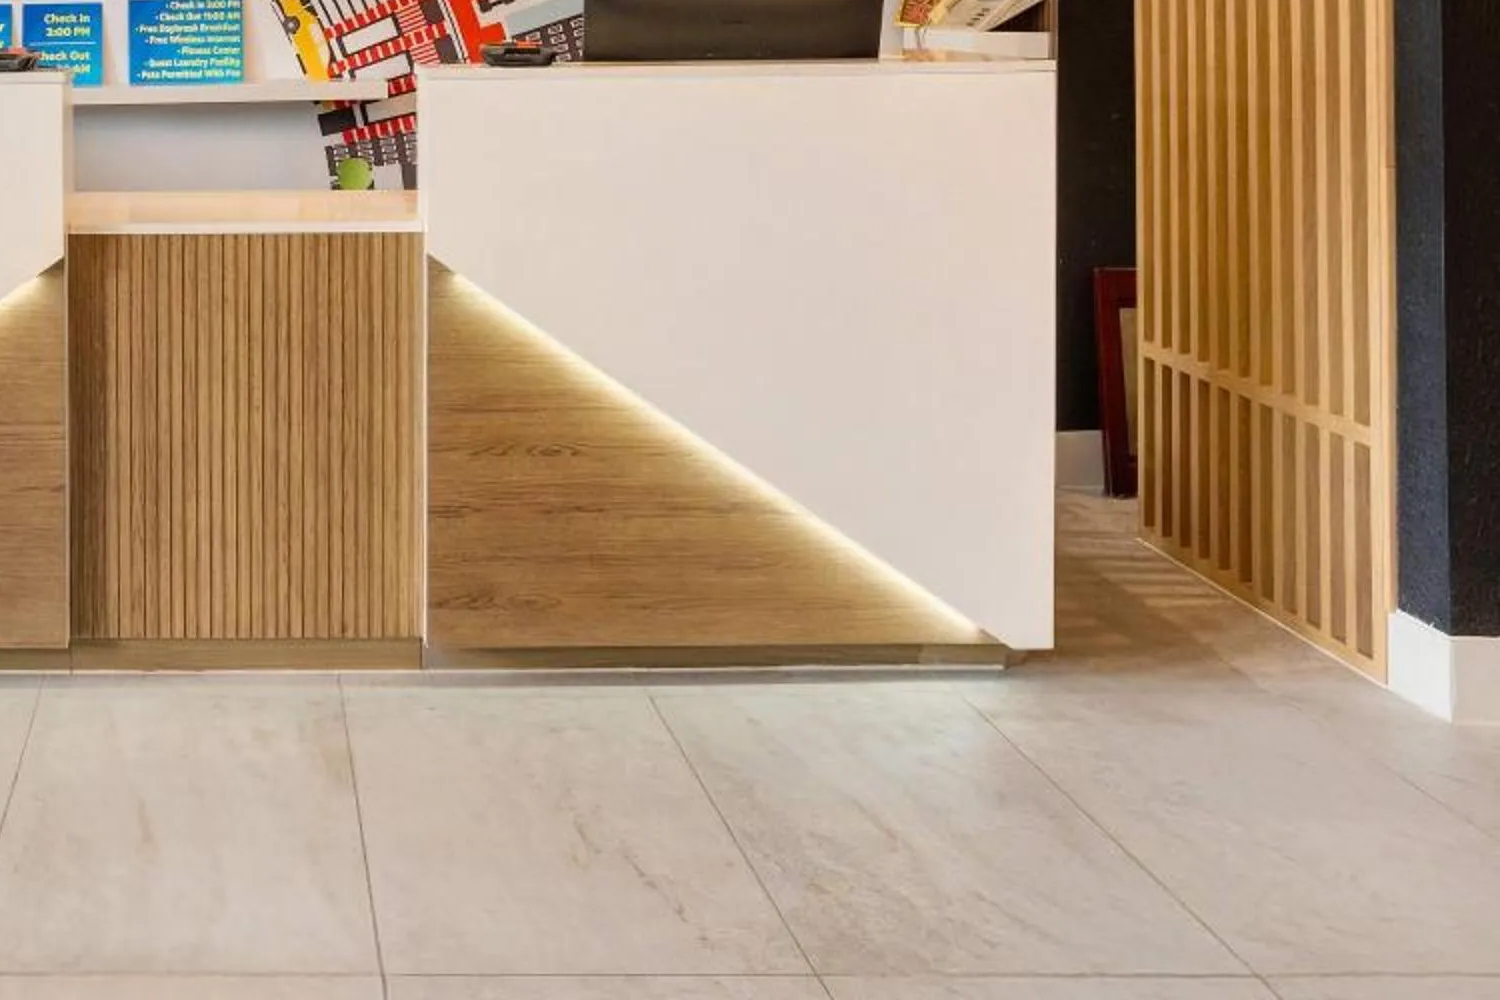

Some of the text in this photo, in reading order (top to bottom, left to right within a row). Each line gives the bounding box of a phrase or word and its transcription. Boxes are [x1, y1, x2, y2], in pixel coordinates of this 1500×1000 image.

[44, 13, 77, 24] Check
[74, 27, 91, 37] PM
[40, 51, 90, 61] heck Out
